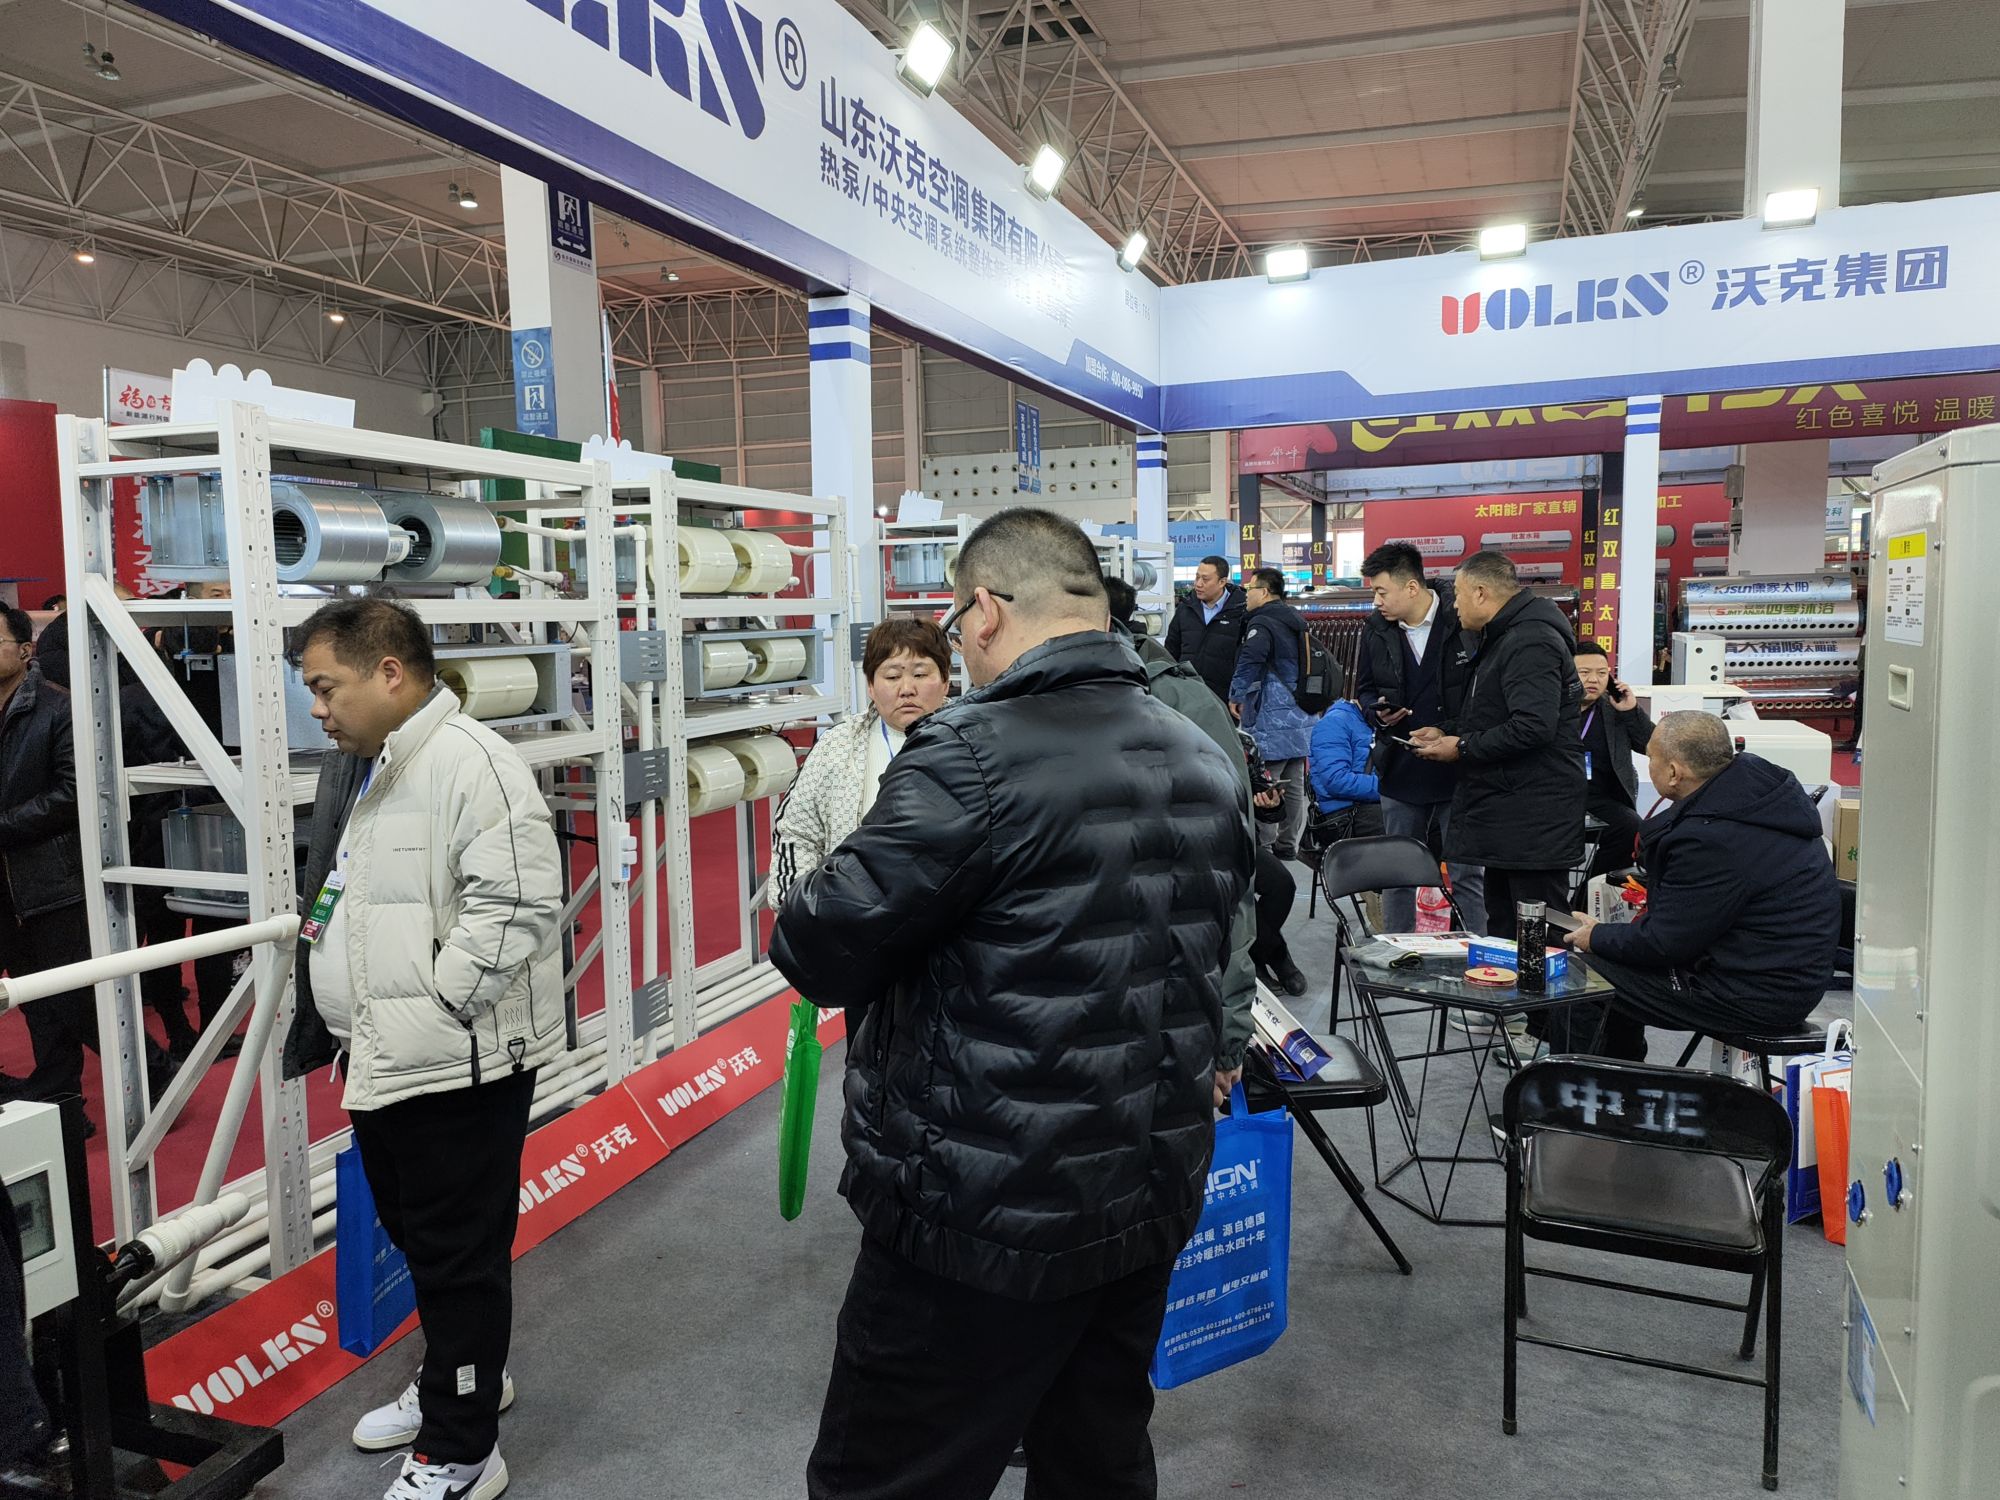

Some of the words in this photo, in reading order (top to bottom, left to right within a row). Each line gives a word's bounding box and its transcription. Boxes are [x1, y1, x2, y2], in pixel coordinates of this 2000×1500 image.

[1711, 245, 1948, 311] 沃克集团
[1795, 402, 1920, 431] 红色喜悦
[1933, 395, 1996, 422] 温暖
[1475, 499, 1577, 518] 太阳能厂家直销
[1766, 602, 1835, 615] 四季沐浴
[727, 1046, 762, 1077] 沃克
[590, 1123, 638, 1164] 沃克
[1204, 1158, 1257, 1196] ION
[1222, 1211, 1266, 1238] 源自德国
